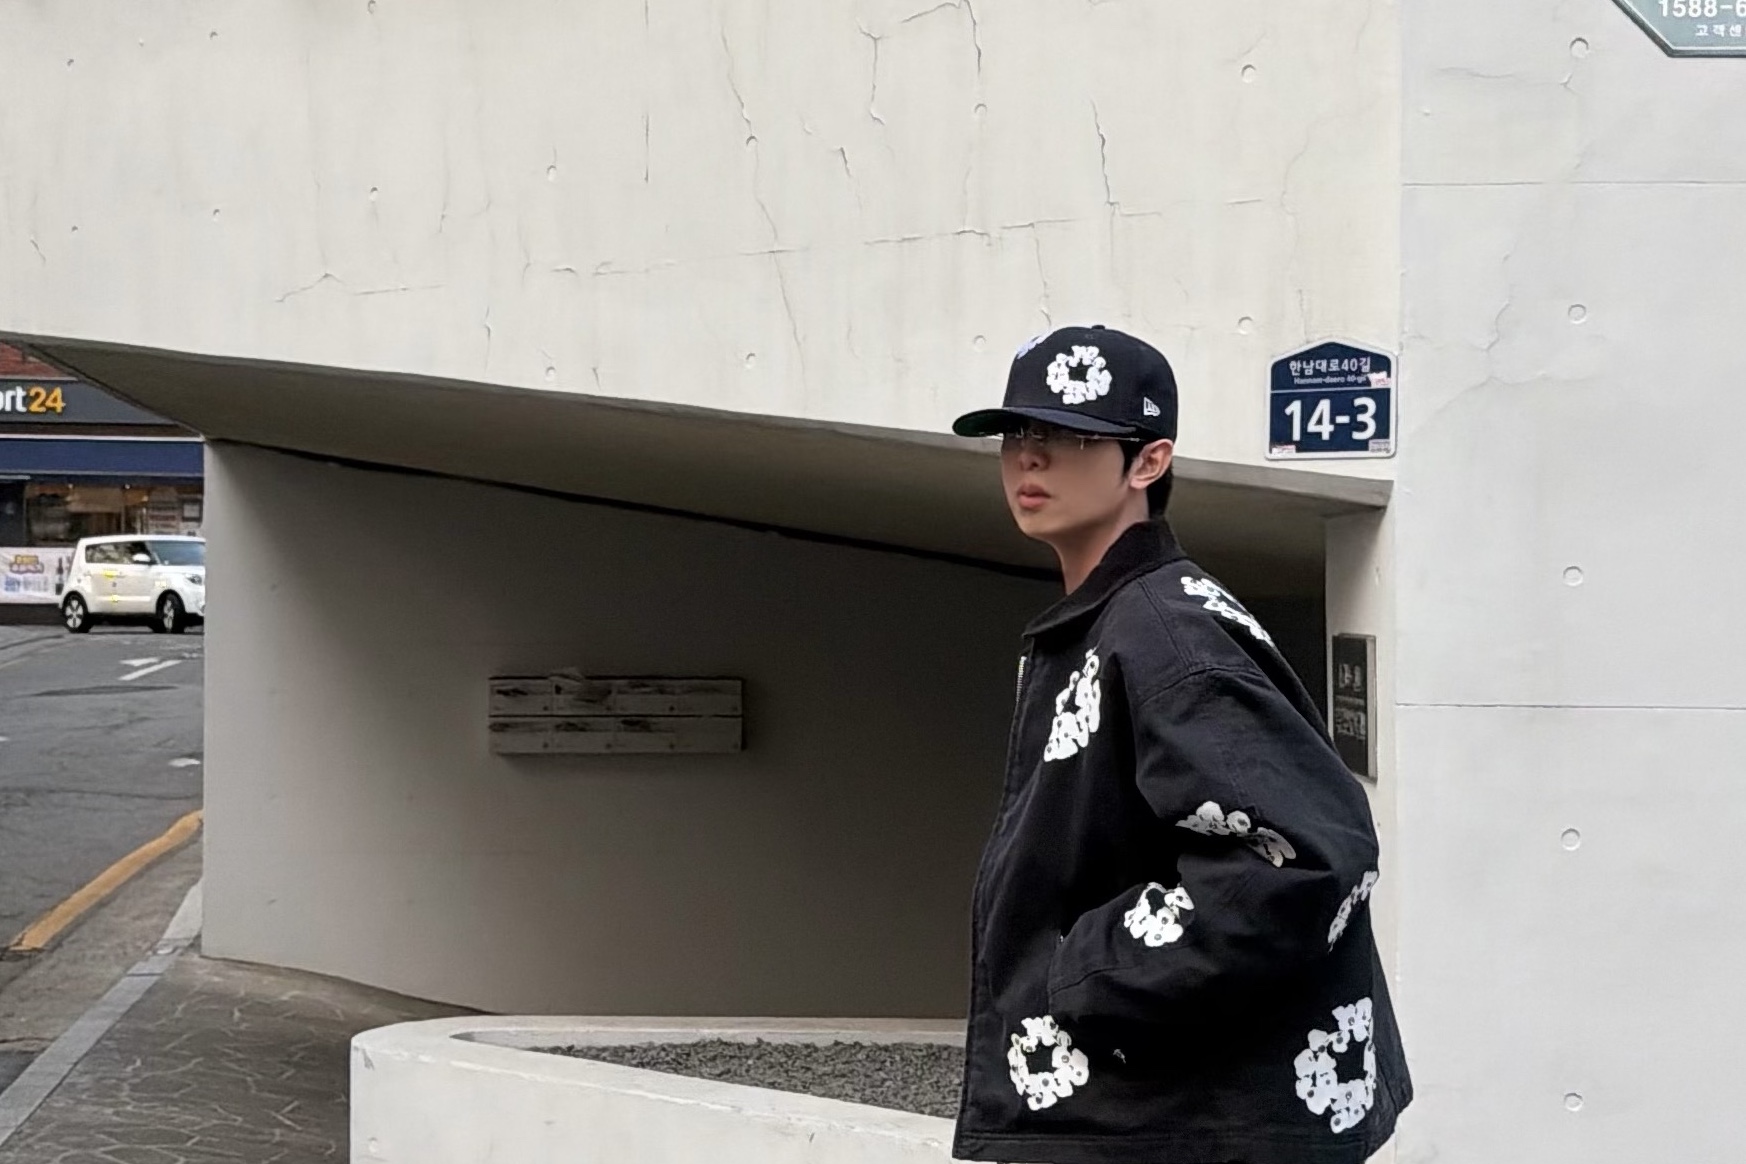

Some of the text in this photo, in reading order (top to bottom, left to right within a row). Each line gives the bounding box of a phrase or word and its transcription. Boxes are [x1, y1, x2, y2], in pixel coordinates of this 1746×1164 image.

[1695, 24, 1746, 37] 고객센
[1289, 356, 1371, 376] 한남대로40길
[1284, 396, 1377, 441] 14-3
